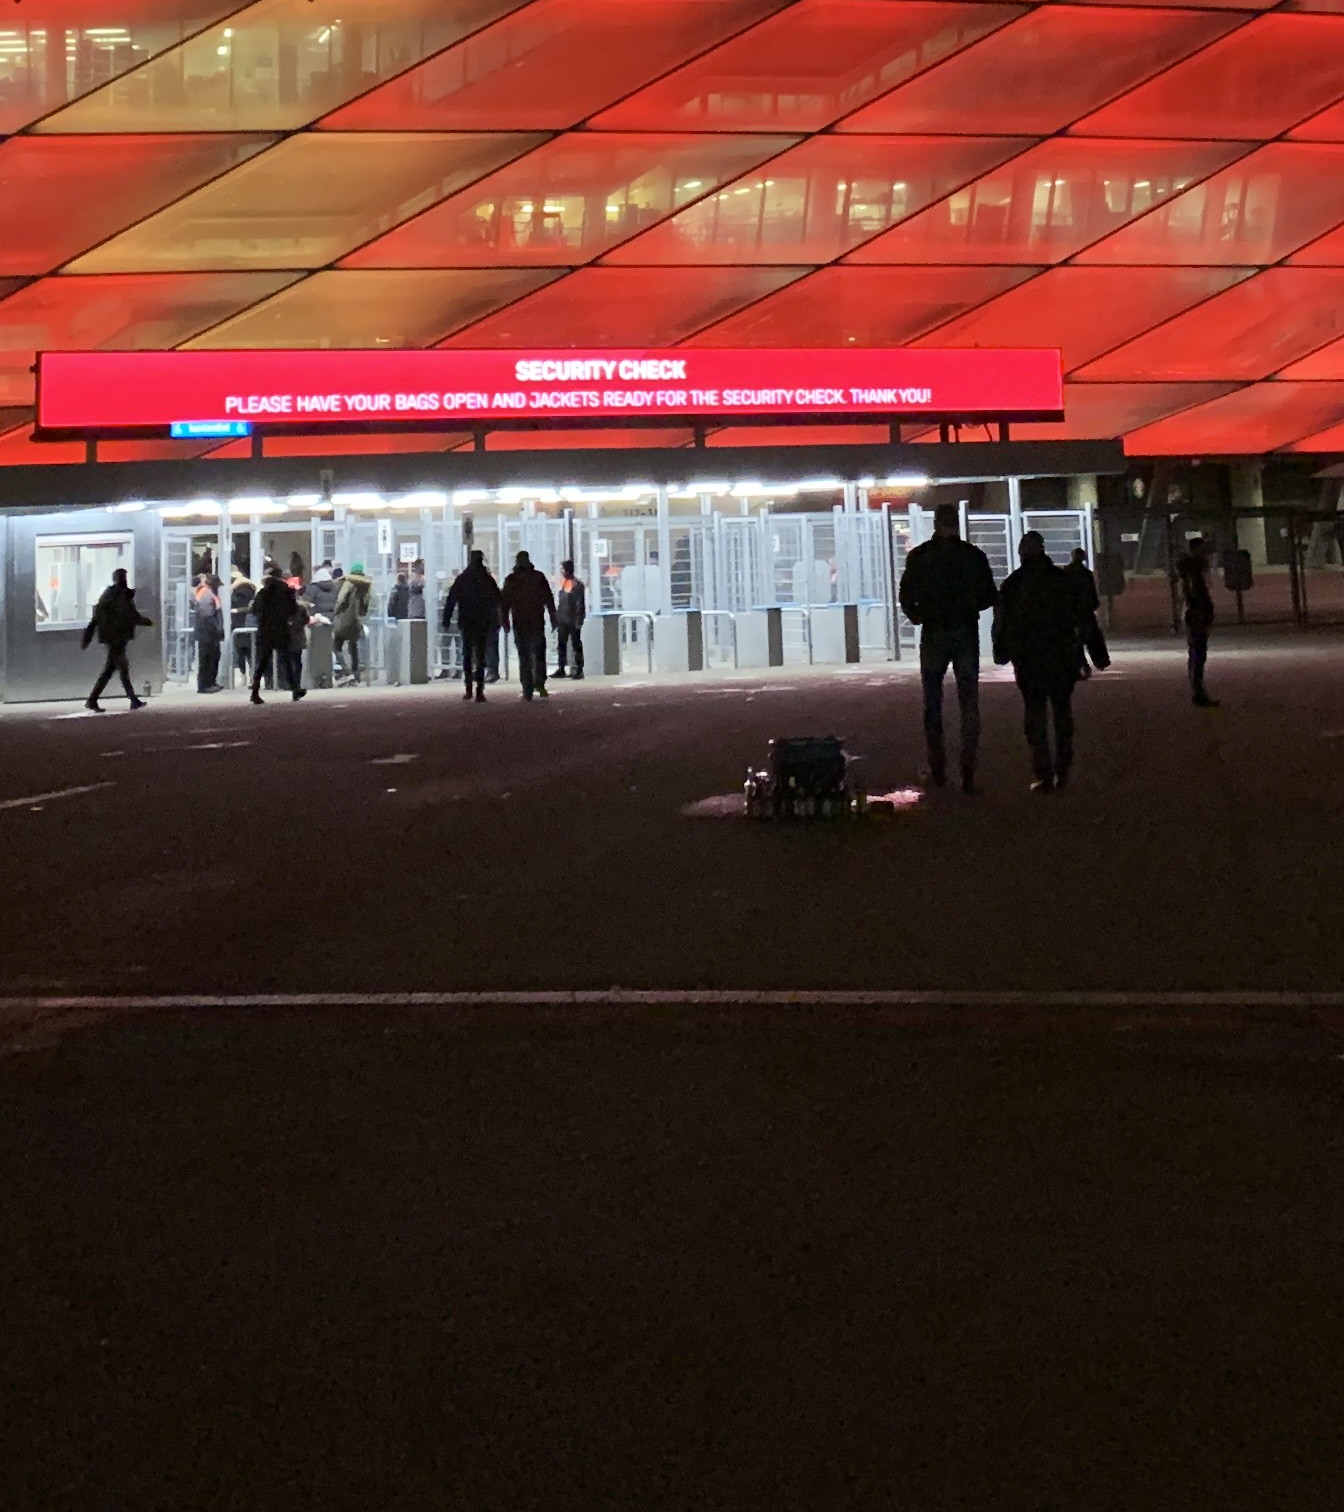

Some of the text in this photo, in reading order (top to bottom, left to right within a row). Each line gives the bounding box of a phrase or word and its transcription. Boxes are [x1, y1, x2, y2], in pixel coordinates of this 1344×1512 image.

[514, 358, 687, 382] SECURITY CHECK
[225, 387, 932, 414] PLEASE HAVE YOUR BAGS OPEN AND JACKETS READY FOR THE SECURITY CHECK. THANK YOU!
